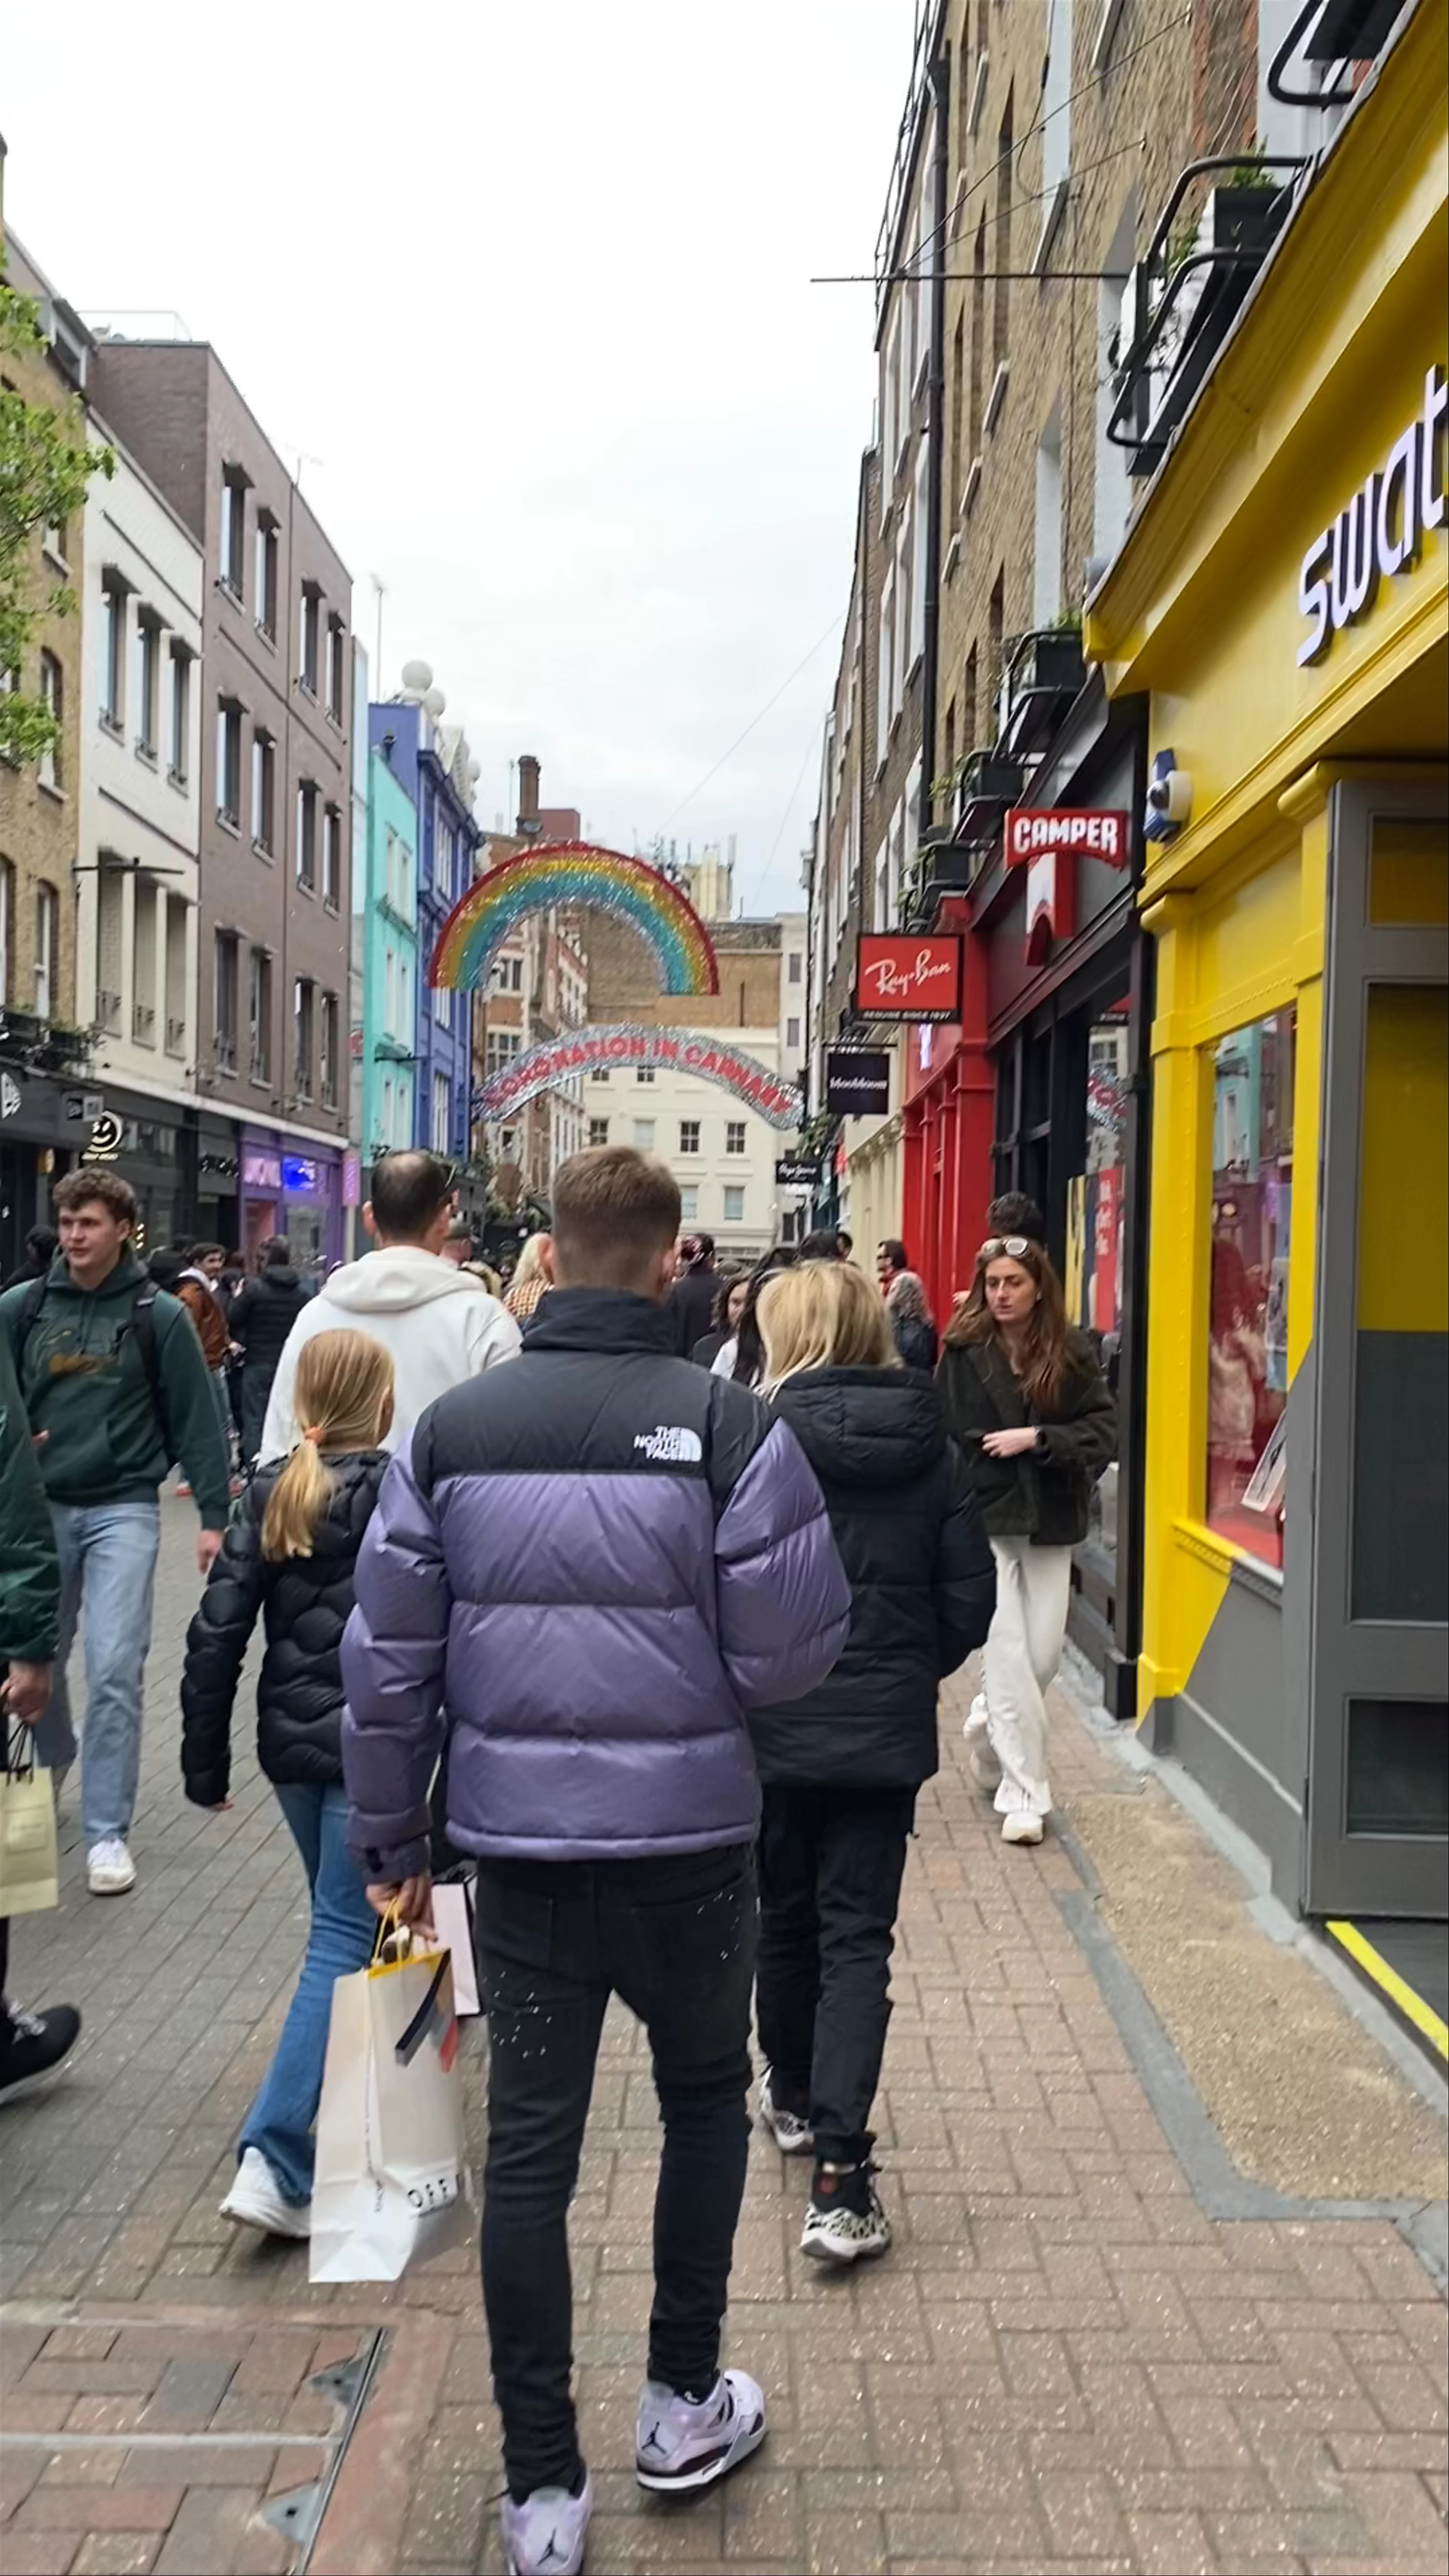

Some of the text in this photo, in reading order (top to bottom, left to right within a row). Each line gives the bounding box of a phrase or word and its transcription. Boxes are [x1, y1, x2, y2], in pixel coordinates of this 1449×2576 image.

[1013, 816, 1118, 857] CAMPER
[864, 949, 951, 996] Ray-Ban
[652, 1038, 678, 1060] IN
